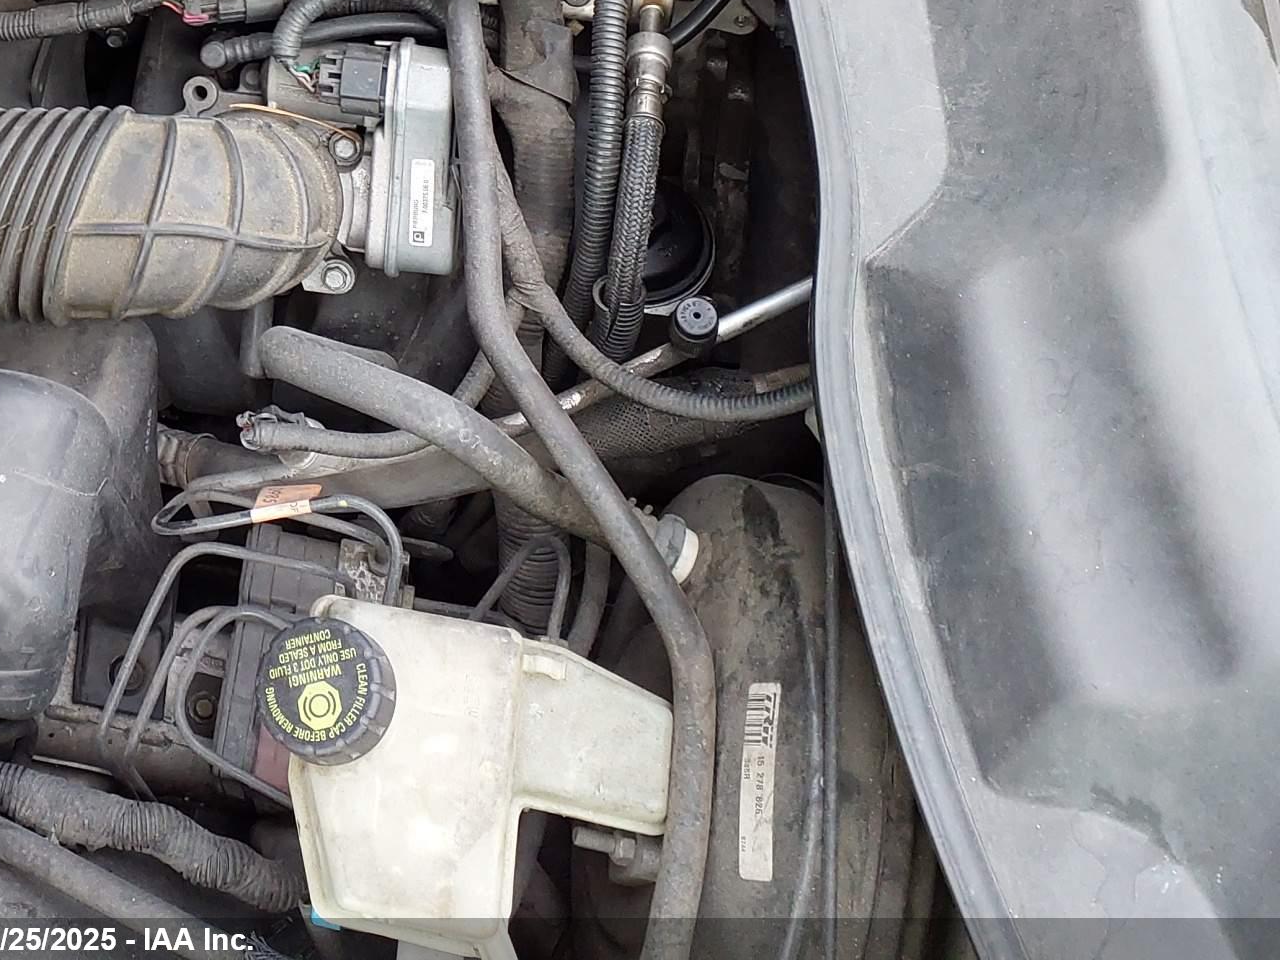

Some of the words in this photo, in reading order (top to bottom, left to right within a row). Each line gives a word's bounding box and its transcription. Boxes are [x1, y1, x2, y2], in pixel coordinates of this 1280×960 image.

[285, 628, 331, 650] CONTAINER
[317, 638, 342, 653] FROM
[278, 646, 309, 664] SEALED
[311, 645, 317, 656] A
[340, 647, 357, 661] USE
[293, 661, 299, 672] 3
[301, 658, 316, 670] DOT
[318, 651, 339, 667] ONLY
[269, 665, 291, 680] FLUID
[288, 664, 342, 688] WARNING!
[356, 663, 368, 696] CLEAN
[265, 686, 294, 734] REMOVING
[344, 695, 365, 726] FILLER
[763, 692, 777, 749] TRW
[292, 726, 327, 742] BEFORE
[328, 721, 346, 739] CAP
[756, 755, 765, 768] 15
